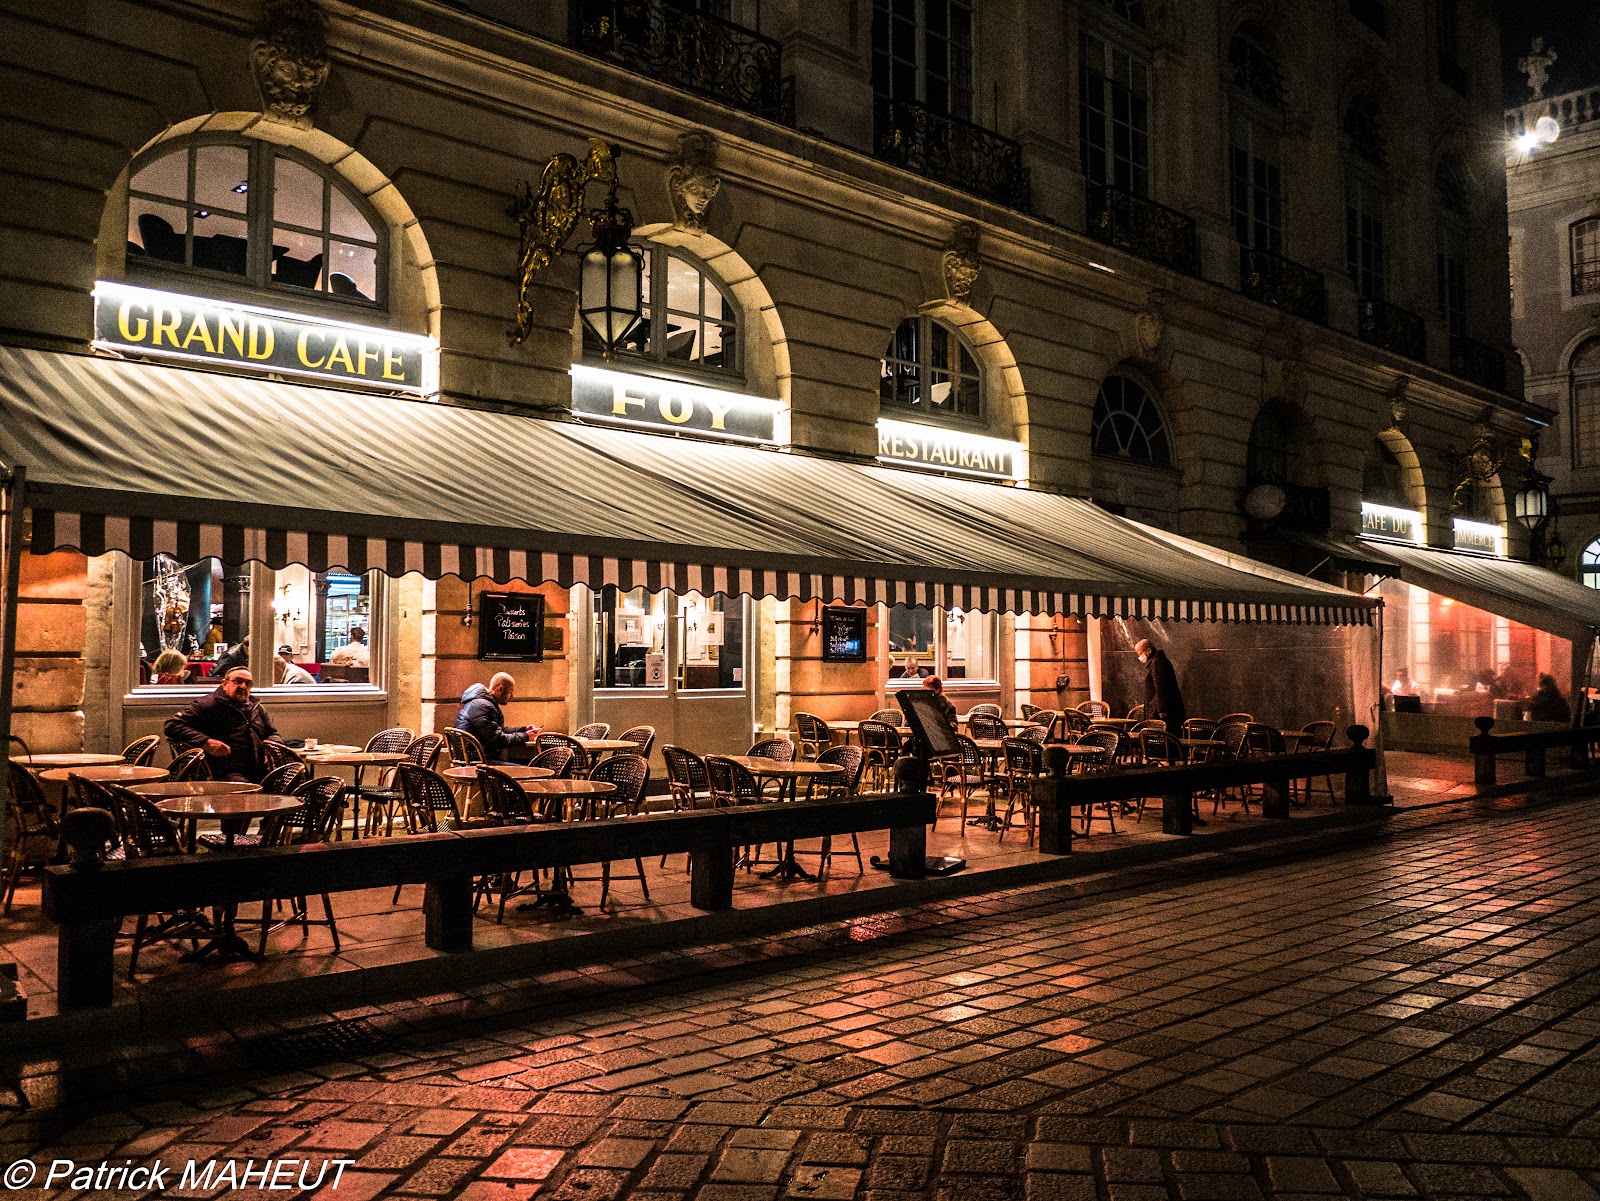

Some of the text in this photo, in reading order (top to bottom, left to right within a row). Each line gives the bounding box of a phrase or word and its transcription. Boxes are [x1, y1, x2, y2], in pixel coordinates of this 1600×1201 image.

[118, 299, 406, 381] GRAND CAFE
[611, 384, 734, 430] FOY
[878, 432, 1006, 472] RESTAURANT
[1392, 515, 1407, 534] DU
[1455, 525, 1493, 548] OMMERCE
